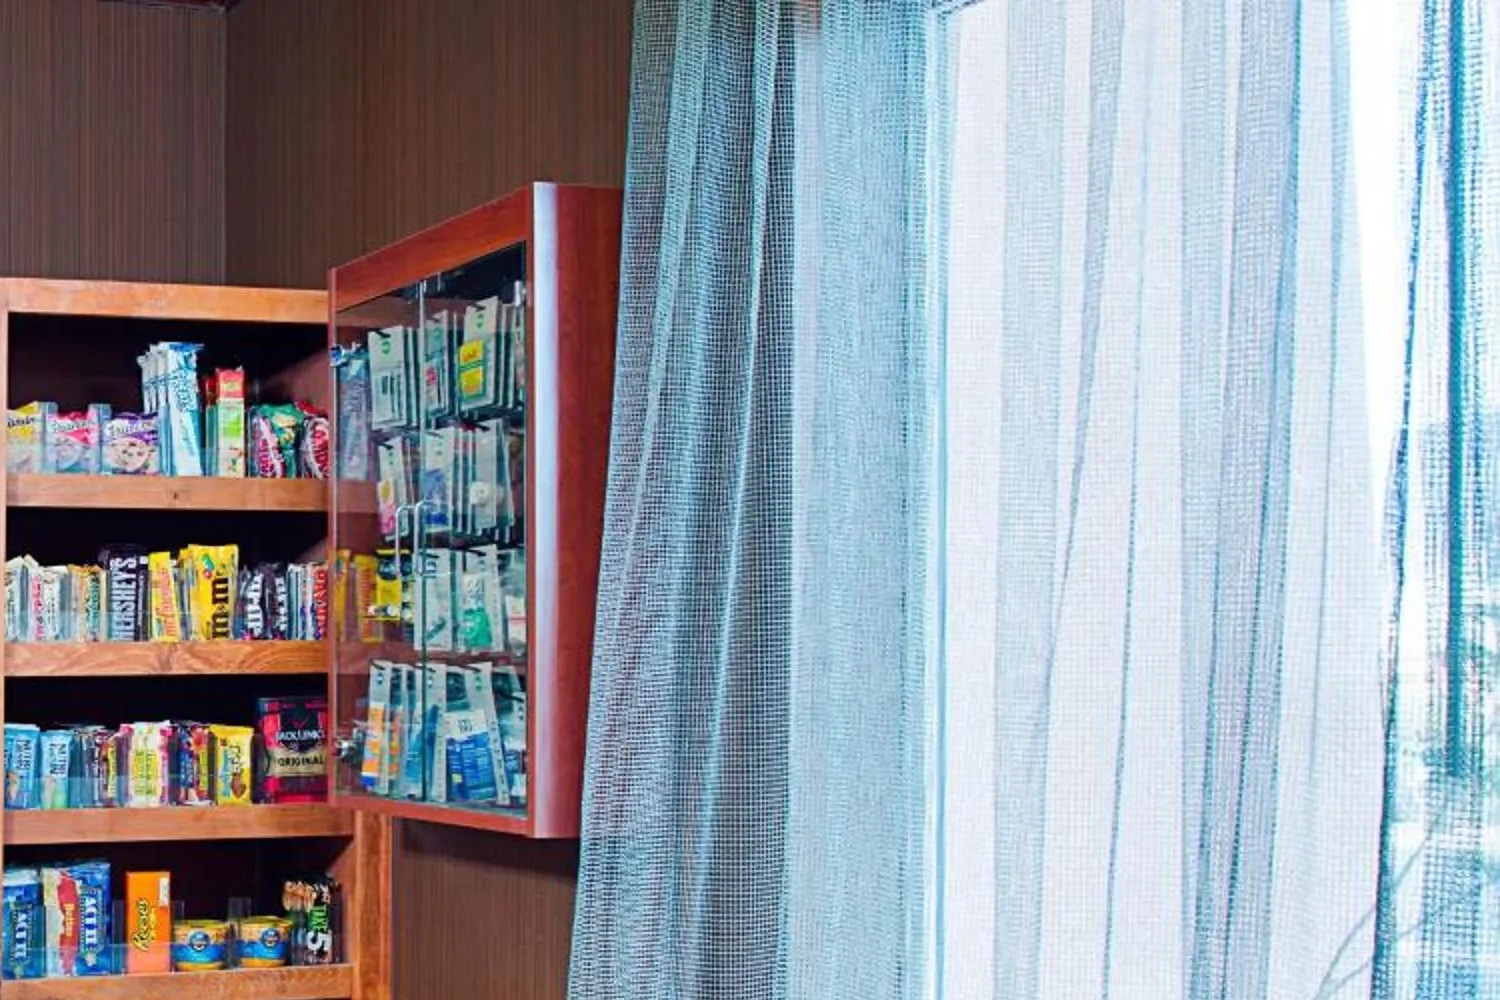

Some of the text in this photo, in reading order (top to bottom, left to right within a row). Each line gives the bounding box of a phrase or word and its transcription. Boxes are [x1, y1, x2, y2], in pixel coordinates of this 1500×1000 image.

[110, 555, 138, 641] HERSHEY'S
[277, 756, 325, 767] ORIGINAL
[306, 930, 332, 953] 5
